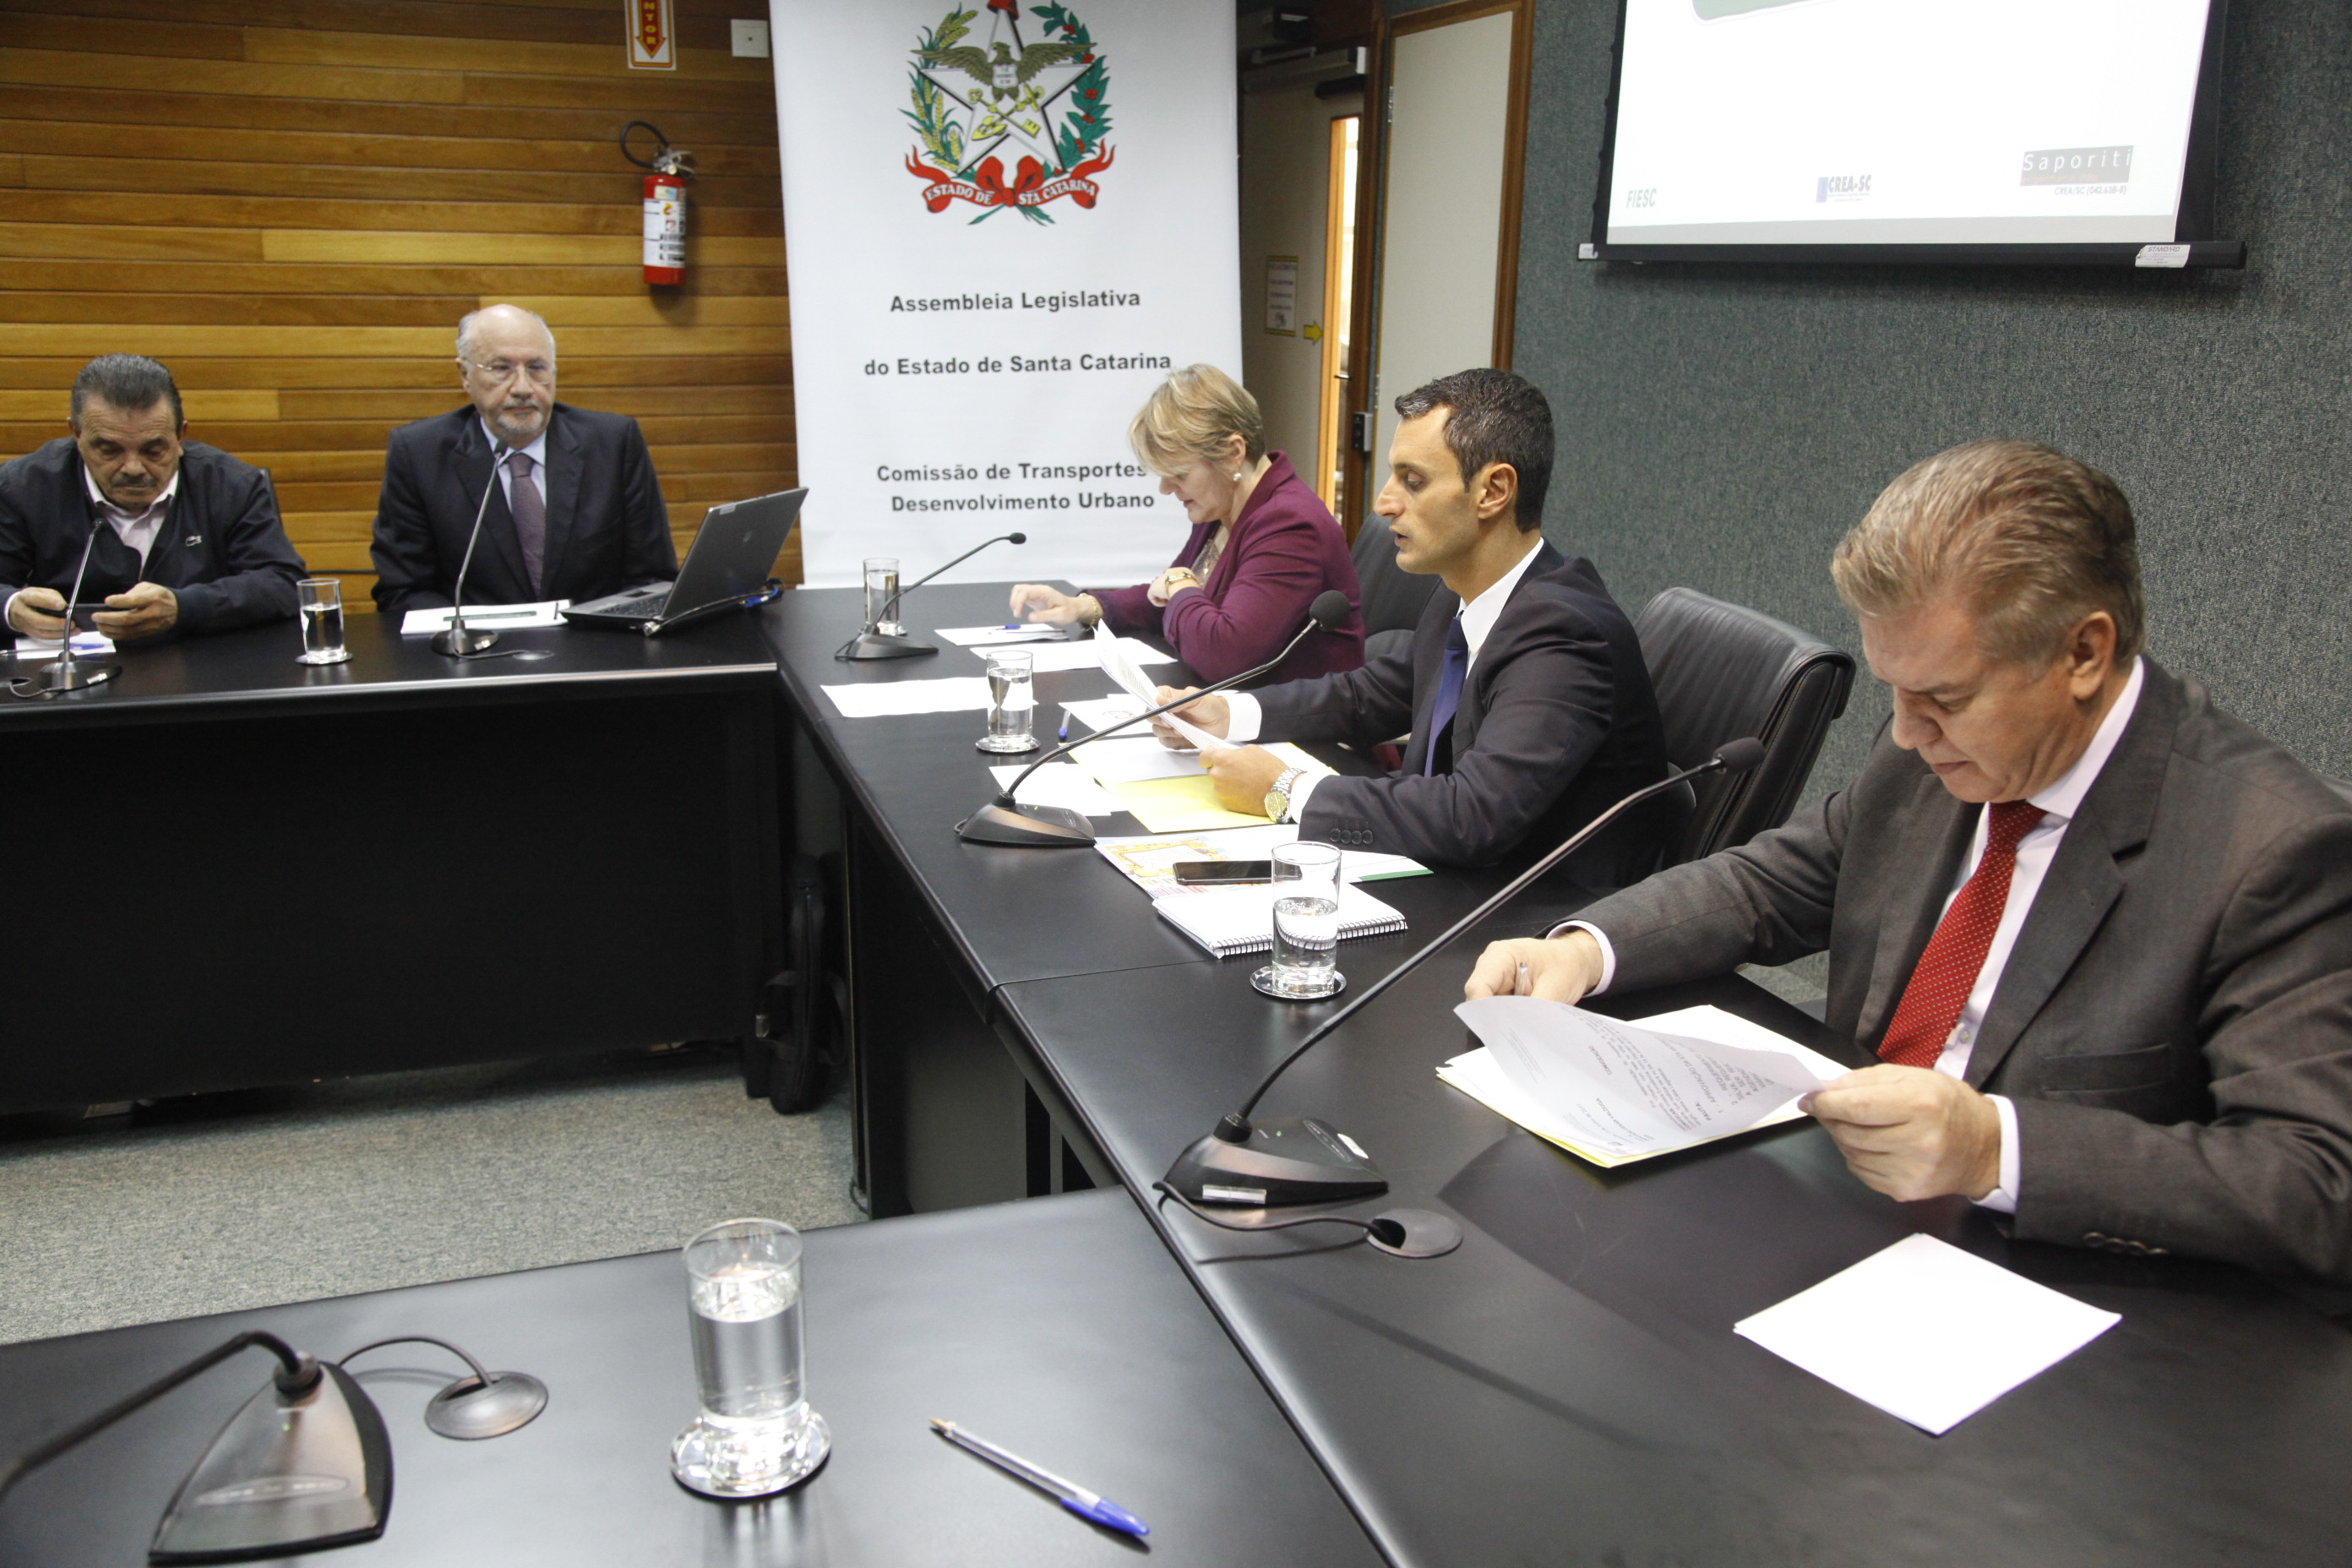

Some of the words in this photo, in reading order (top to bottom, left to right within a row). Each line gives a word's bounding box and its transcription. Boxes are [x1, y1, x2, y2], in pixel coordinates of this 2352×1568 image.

[2023, 150, 2132, 172] Saporiti
[926, 184, 974, 202] ESTADO
[975, 191, 993, 205] DE
[1043, 179, 1096, 200] CATARINA
[1625, 188, 1657, 209] FIESC
[890, 293, 1013, 312] Assembleia
[1021, 290, 1141, 312] Legislativa
[864, 360, 889, 375] do
[897, 357, 970, 374] Estado
[977, 357, 1003, 373] de
[1010, 356, 1072, 372] Santa
[1080, 353, 1171, 370] Catarina
[877, 464, 978, 482] Comissão
[986, 463, 1010, 479] de
[1018, 462, 1146, 482] Transportes
[891, 494, 1070, 511] Desenvolvimento
[1078, 492, 1155, 508] Urbano
